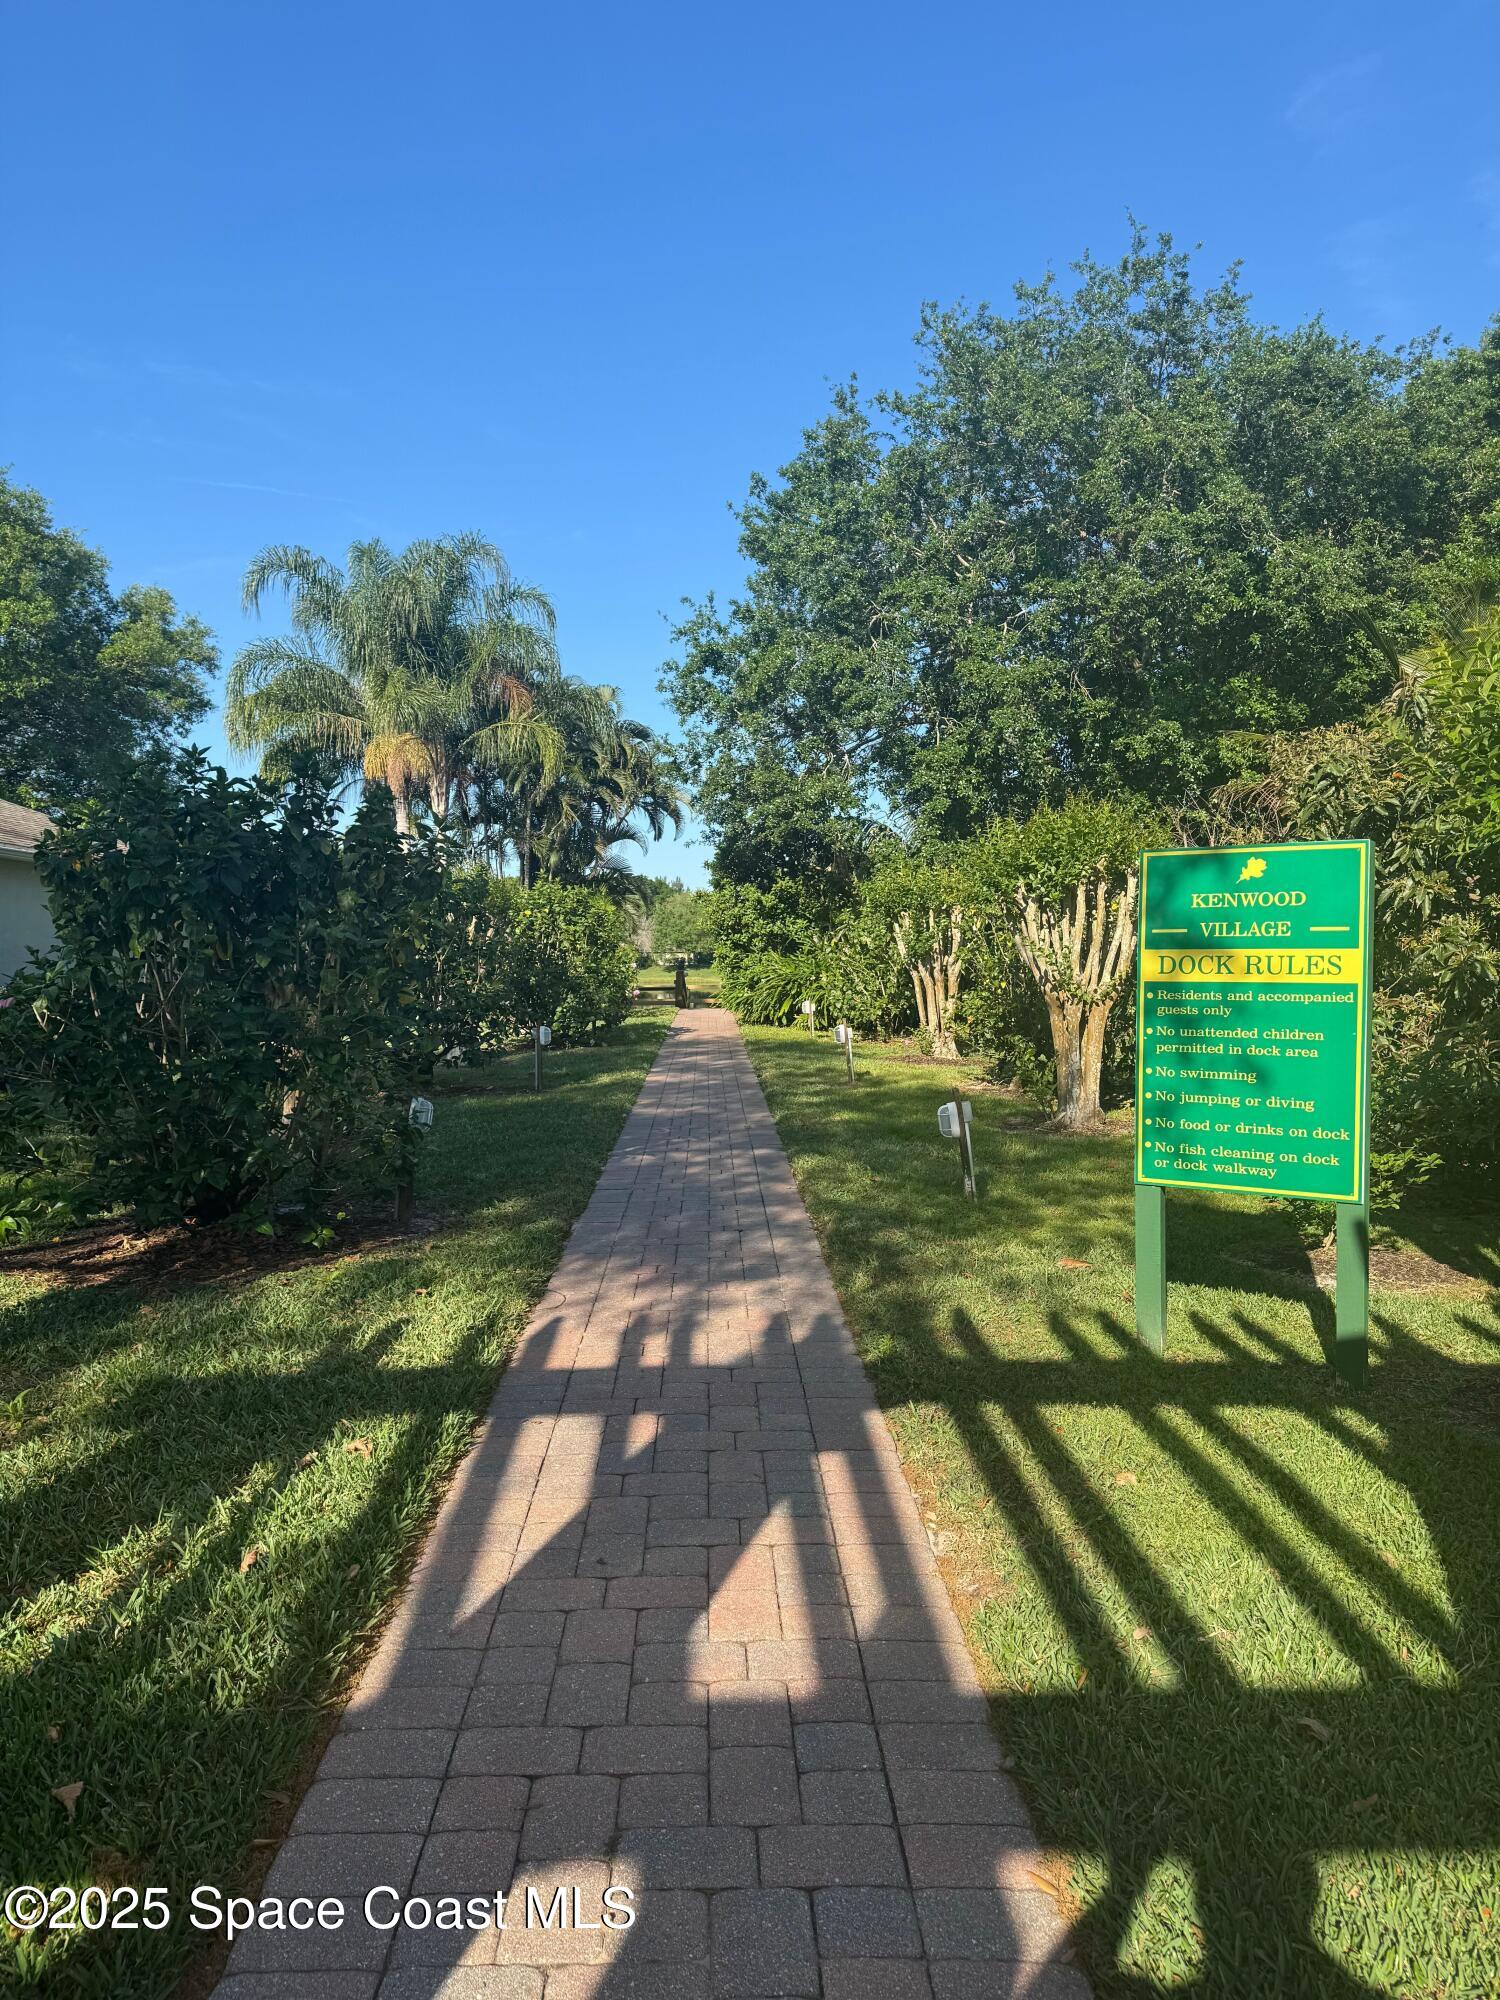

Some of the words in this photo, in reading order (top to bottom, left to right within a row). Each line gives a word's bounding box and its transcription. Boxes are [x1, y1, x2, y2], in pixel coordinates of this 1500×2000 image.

[1191, 891, 1306, 908] KENWOOD
[1200, 921, 1291, 938] VILLAGE
[1158, 955, 1235, 976] DOCK
[1244, 955, 1342, 976] RULES
[1157, 990, 1222, 1001] Residents
[1227, 990, 1252, 1001] and
[1258, 991, 1354, 1004] accompanied
[1157, 1006, 1198, 1016] guests
[1203, 1006, 1232, 1017] only
[1156, 1026, 1175, 1037] No
[1179, 1027, 1258, 1039] unattended
[1263, 1028, 1324, 1040] children
[1156, 1044, 1223, 1056] permitted
[1228, 1045, 1242, 1055] in
[1246, 1045, 1281, 1056] dock
[1285, 1048, 1319, 1057] area
[1155, 1067, 1175, 1078] No
[1180, 1067, 1257, 1083] swimming
[1155, 1091, 1175, 1102] No
[1179, 1091, 1240, 1107] jumping
[1245, 1096, 1261, 1106] or
[1266, 1096, 1314, 1112] diving
[1155, 1118, 1175, 1129] No
[1179, 1118, 1210, 1131] food
[1215, 1122, 1231, 1132] or
[1235, 1122, 1284, 1137] drinks
[1289, 1128, 1308, 1138] on
[1312, 1127, 1350, 1140] dock
[1155, 1142, 1174, 1153] No
[1178, 1142, 1206, 1156] fish
[1211, 1146, 1274, 1163] cleaning
[1279, 1153, 1298, 1163] on
[1303, 1152, 1340, 1166] dock
[1154, 1158, 1169, 1168] or
[1174, 1159, 1207, 1171] dock
[1213, 1162, 1277, 1179] walkway
